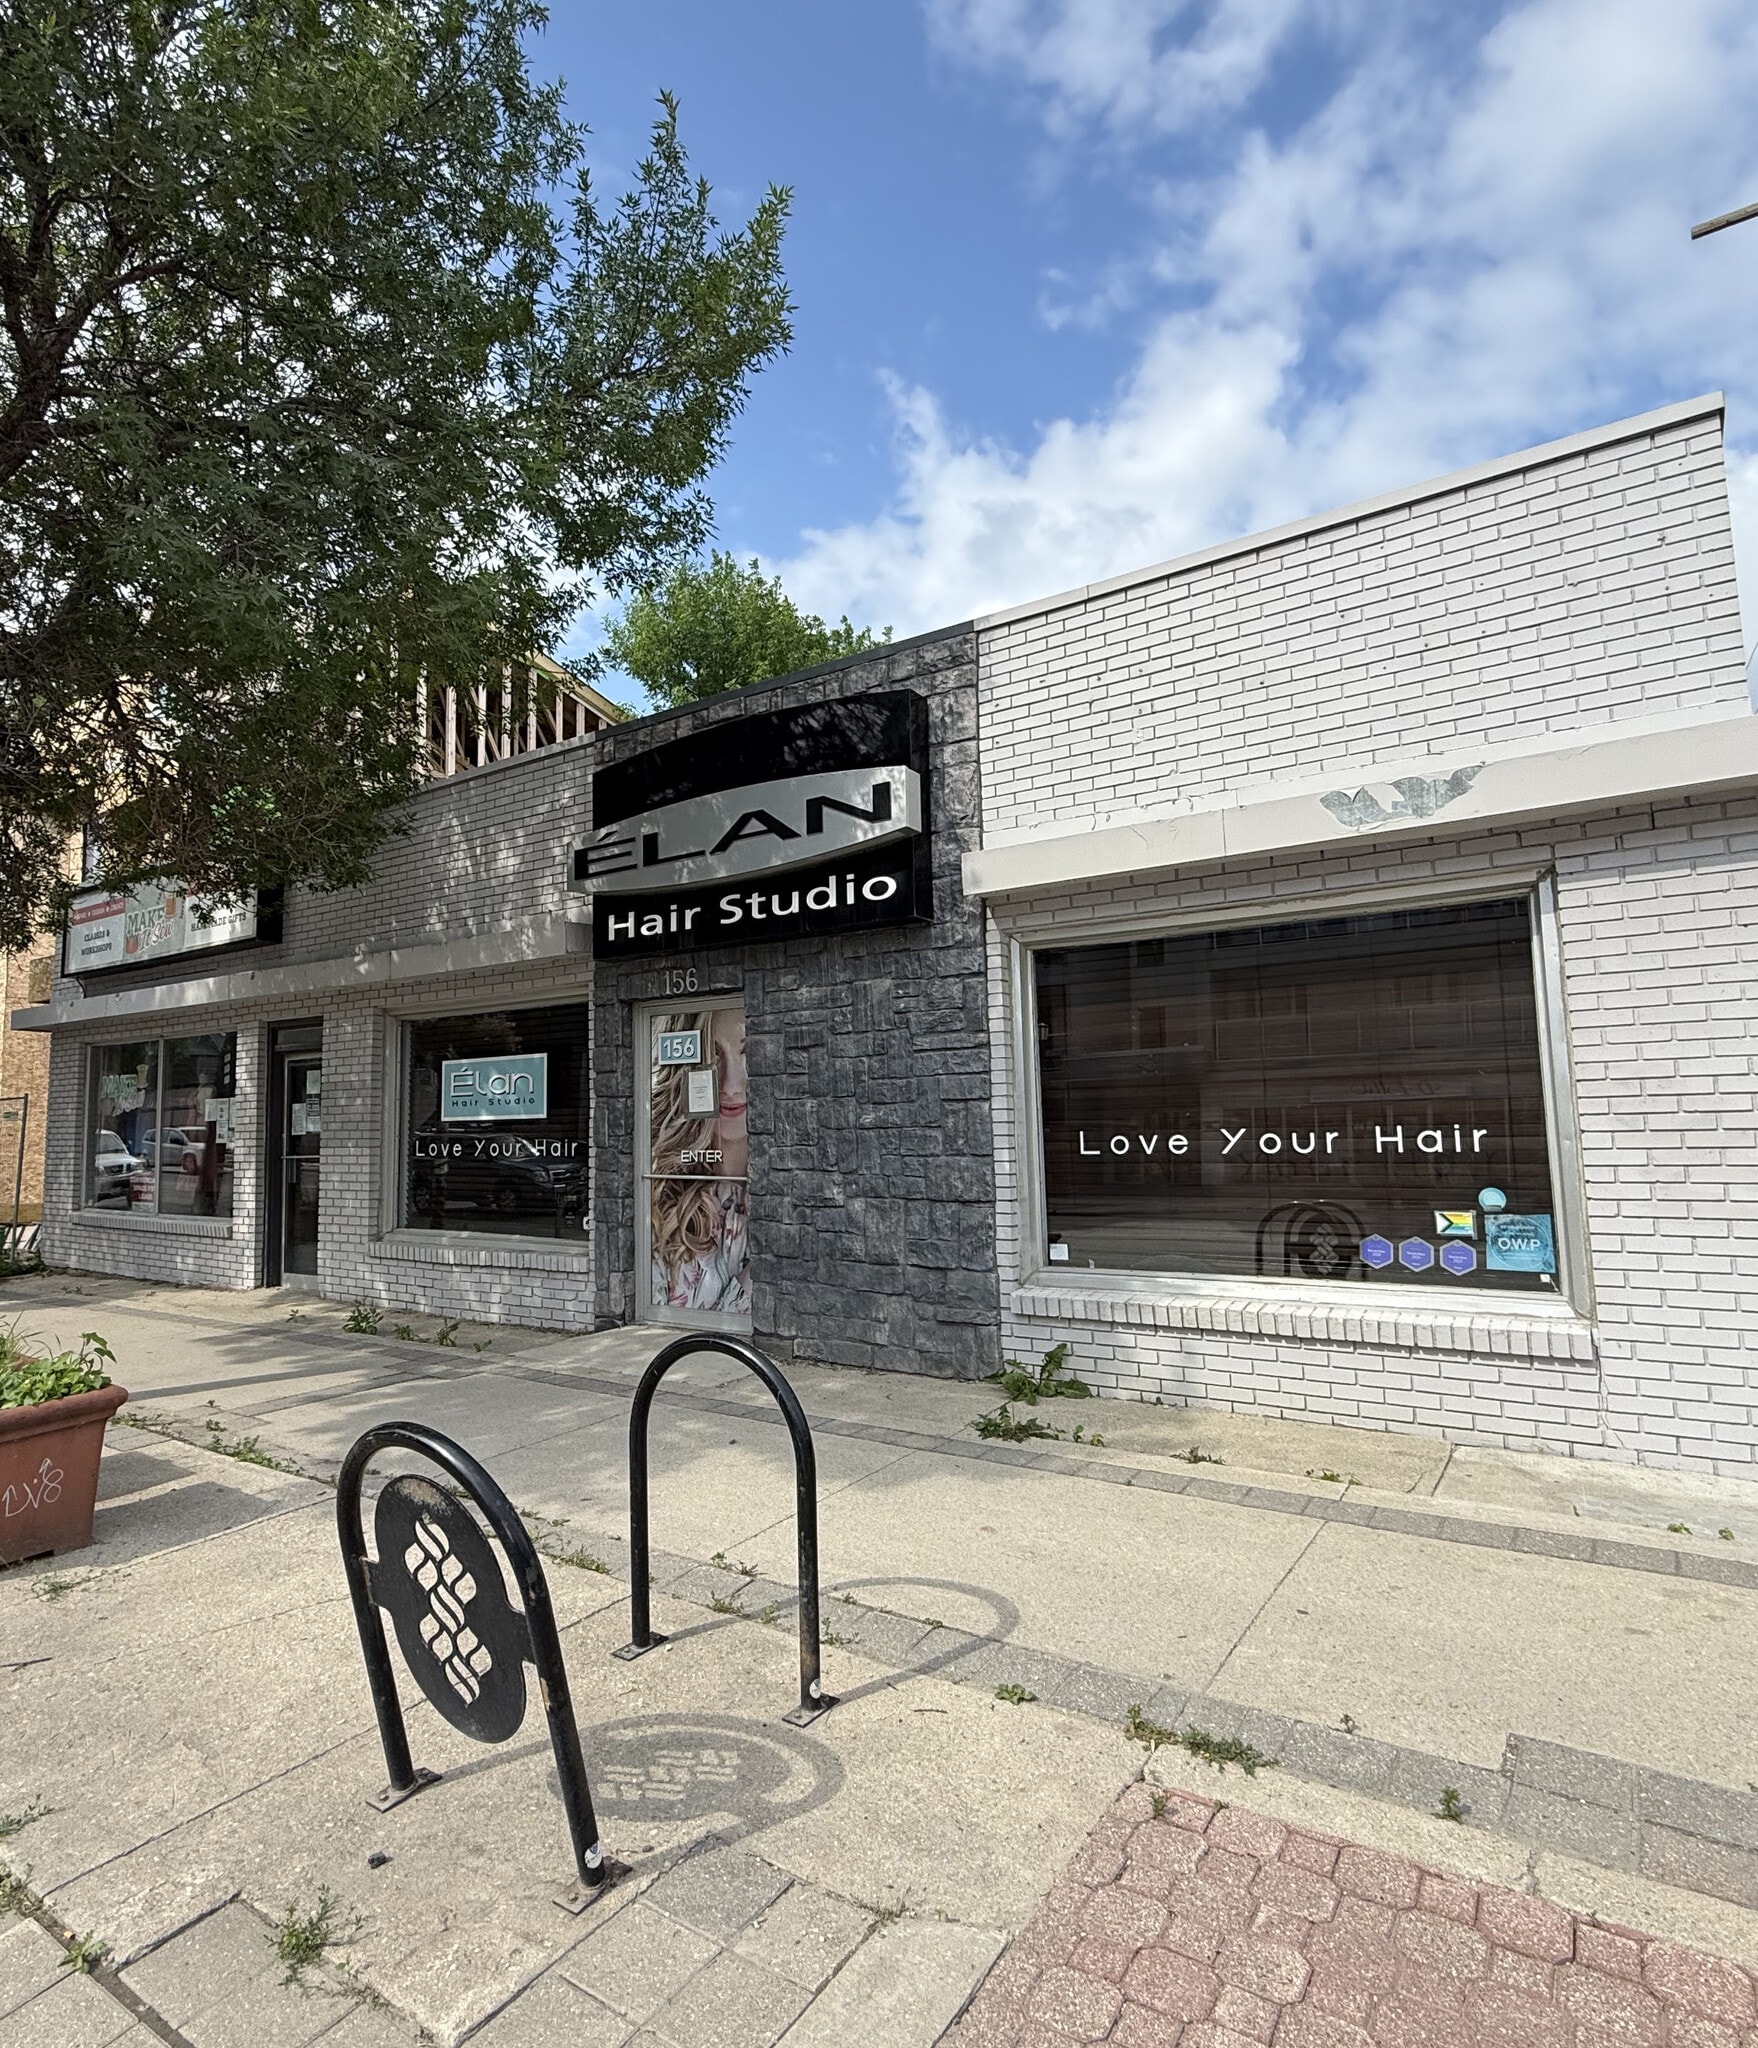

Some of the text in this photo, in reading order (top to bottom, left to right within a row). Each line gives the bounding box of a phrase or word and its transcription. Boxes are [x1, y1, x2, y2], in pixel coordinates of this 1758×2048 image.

[574, 781, 891, 880] ÉLAN
[127, 906, 165, 935] MAKE
[228, 912, 247, 924] GIFTS
[608, 873, 898, 941] Hair Studio
[664, 968, 698, 995] 156
[663, 1037, 695, 1059] 156
[451, 1066, 535, 1098] Élan
[452, 1097, 536, 1107] Hair Studio
[415, 1139, 578, 1157] Love Your Hair
[1079, 1124, 1488, 1155] Love Your Hair
[680, 1150, 723, 1164] ENTER
